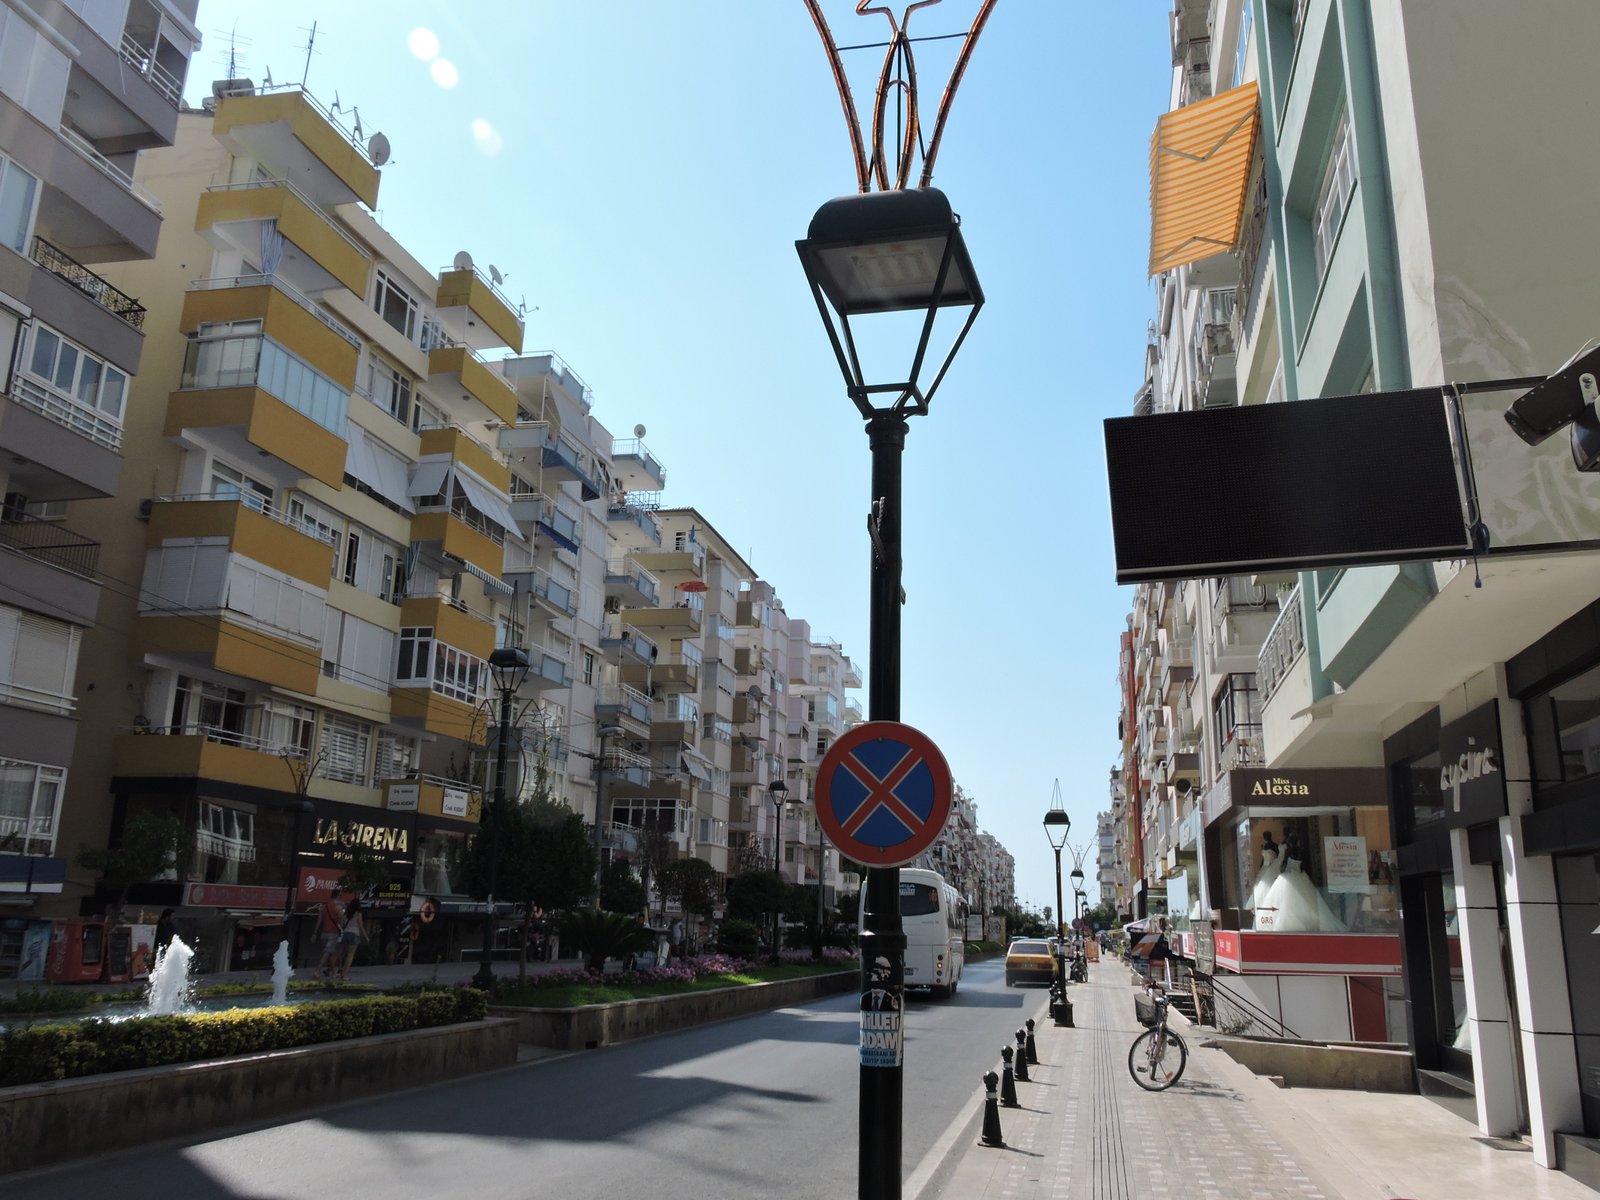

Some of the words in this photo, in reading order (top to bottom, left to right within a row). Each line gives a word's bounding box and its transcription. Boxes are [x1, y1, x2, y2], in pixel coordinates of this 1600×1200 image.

[1251, 779, 1310, 796] Alesia
[1272, 777, 1290, 785] Miss
[313, 818, 338, 844] LA
